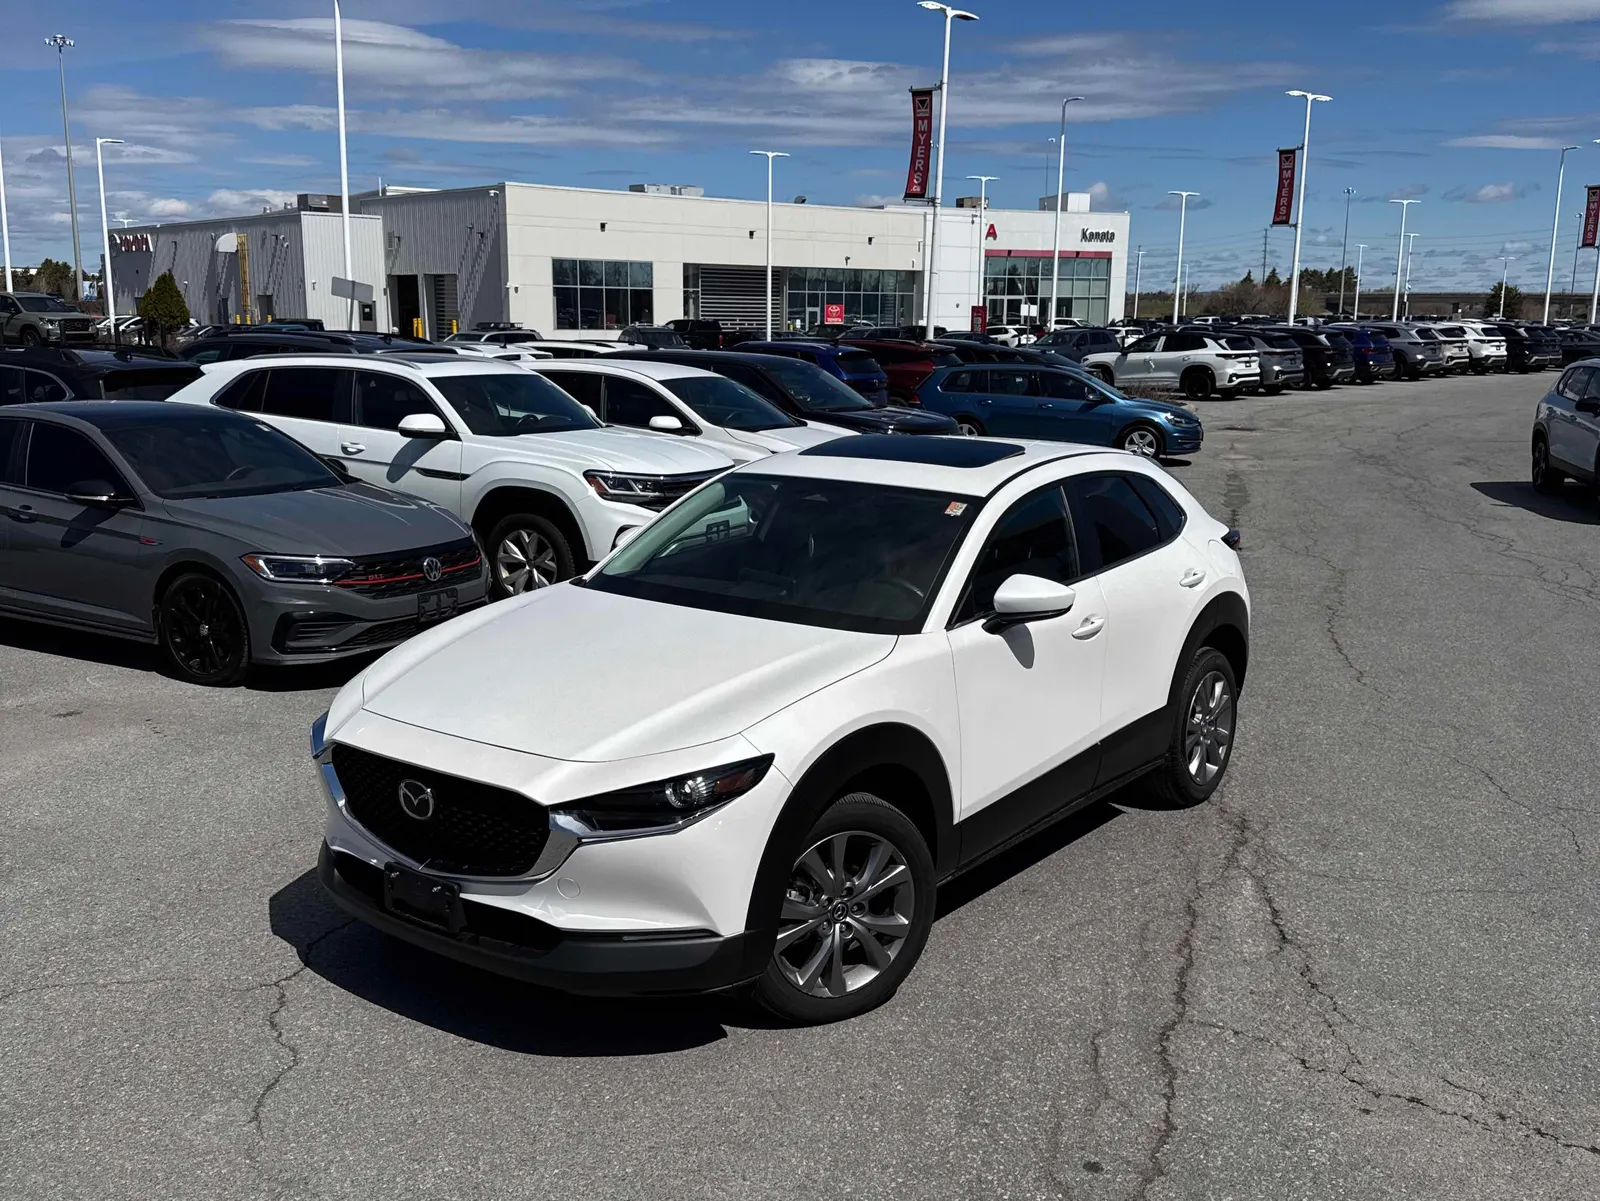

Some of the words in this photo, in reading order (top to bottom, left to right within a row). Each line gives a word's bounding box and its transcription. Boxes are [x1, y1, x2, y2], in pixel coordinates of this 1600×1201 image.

[913, 119, 928, 184] MYERS
[1279, 170, 1291, 215] MYERS
[1080, 227, 1115, 243] Kanata
[1587, 202, 1597, 239] MYERS
